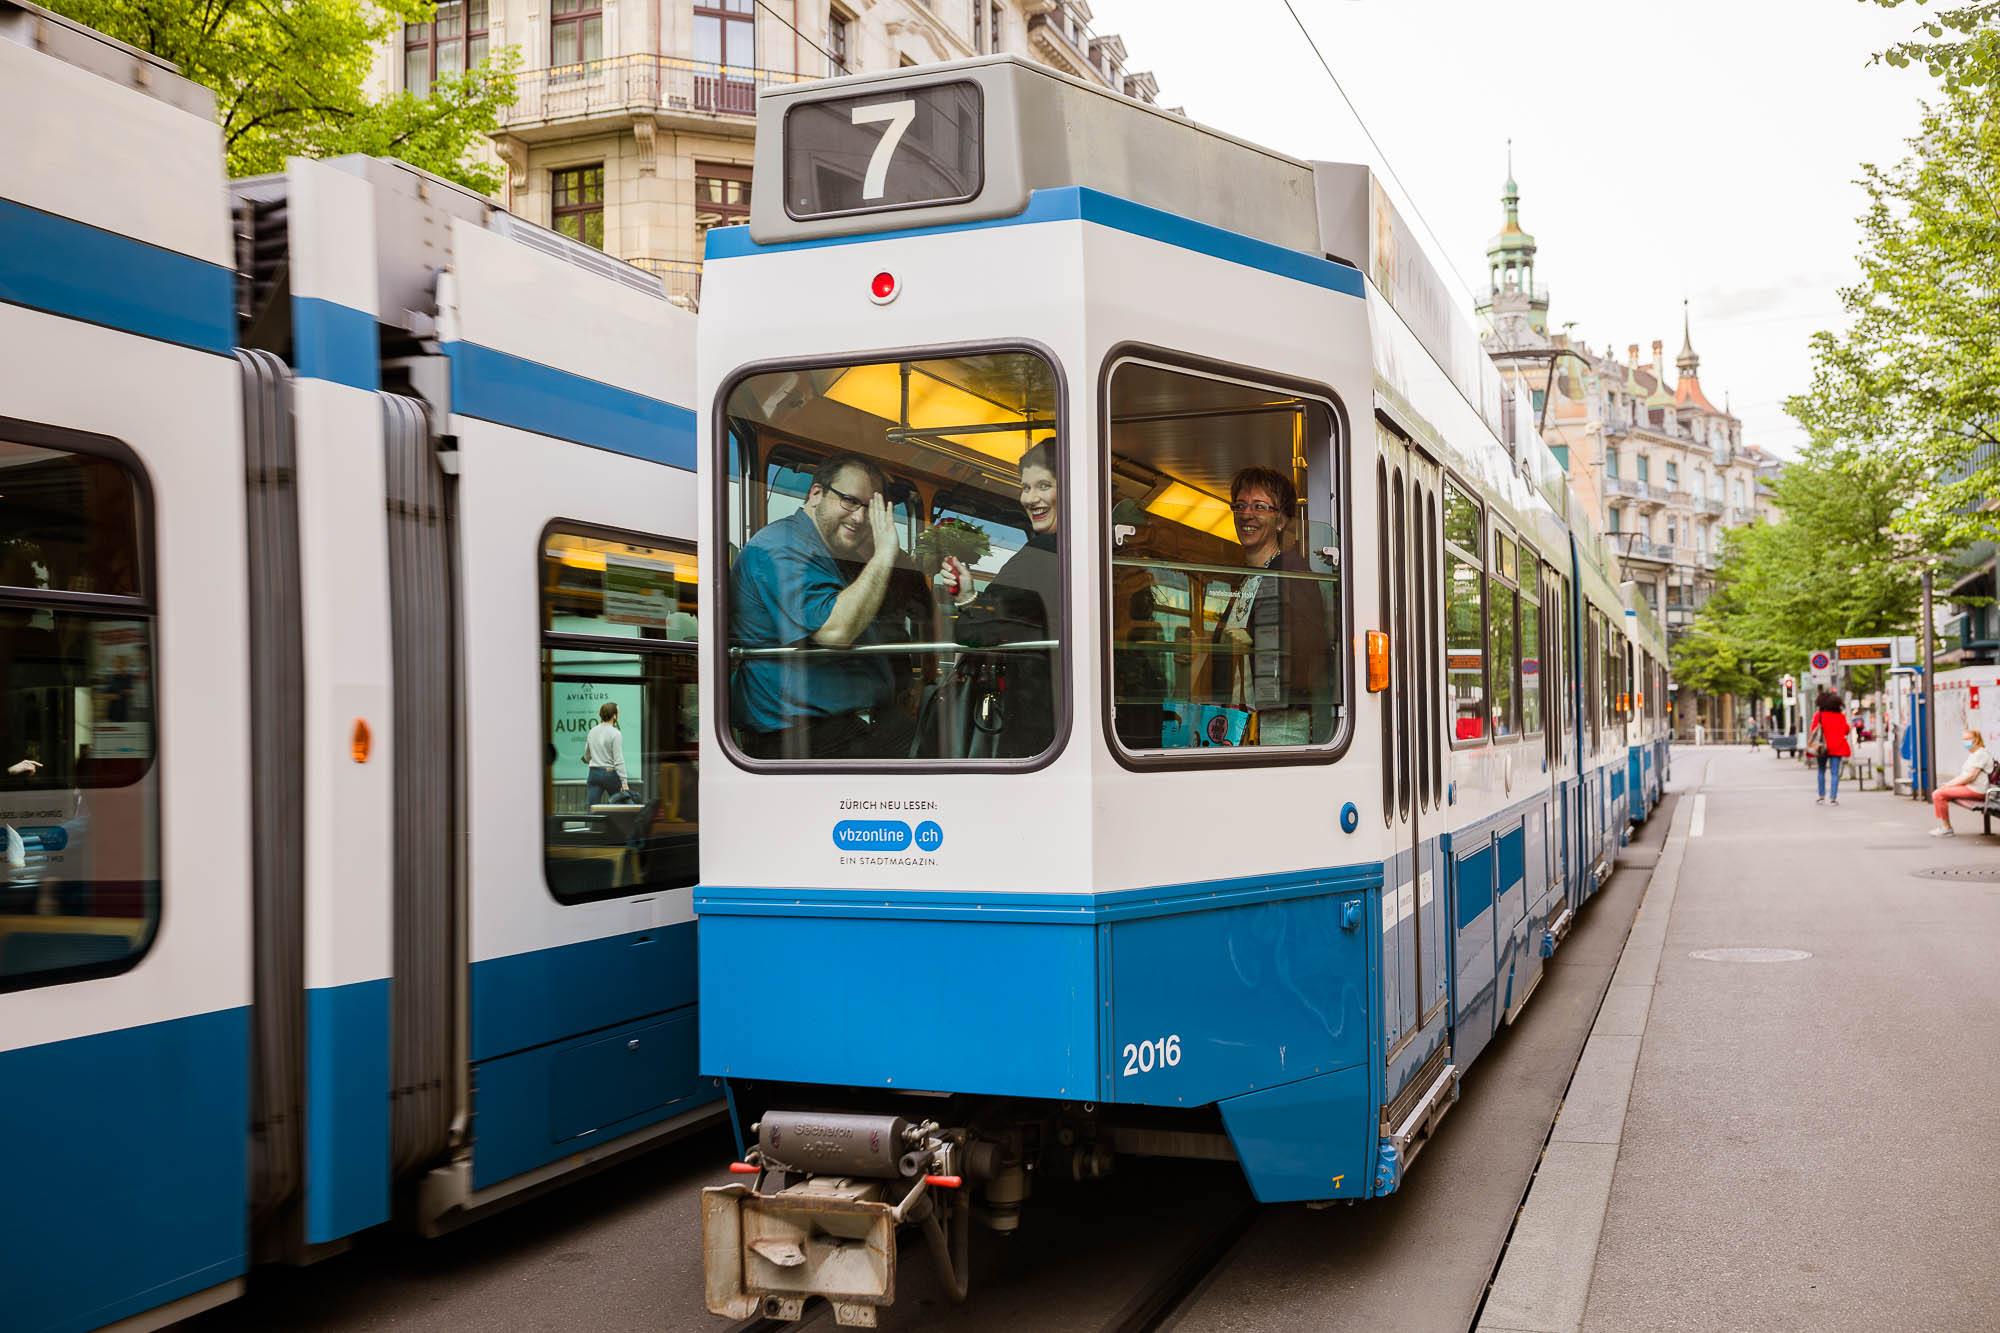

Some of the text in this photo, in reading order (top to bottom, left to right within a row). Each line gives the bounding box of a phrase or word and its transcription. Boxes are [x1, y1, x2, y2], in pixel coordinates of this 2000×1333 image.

[851, 99, 916, 200] 7
[555, 718, 621, 733] AUROA
[839, 798, 938, 810] ZÜRICH NEU LESEN:
[839, 828, 904, 841] vbzonline
[840, 857, 938, 866] EIN STADTMAGAZIN.
[1122, 1034, 1181, 1077] 2016
